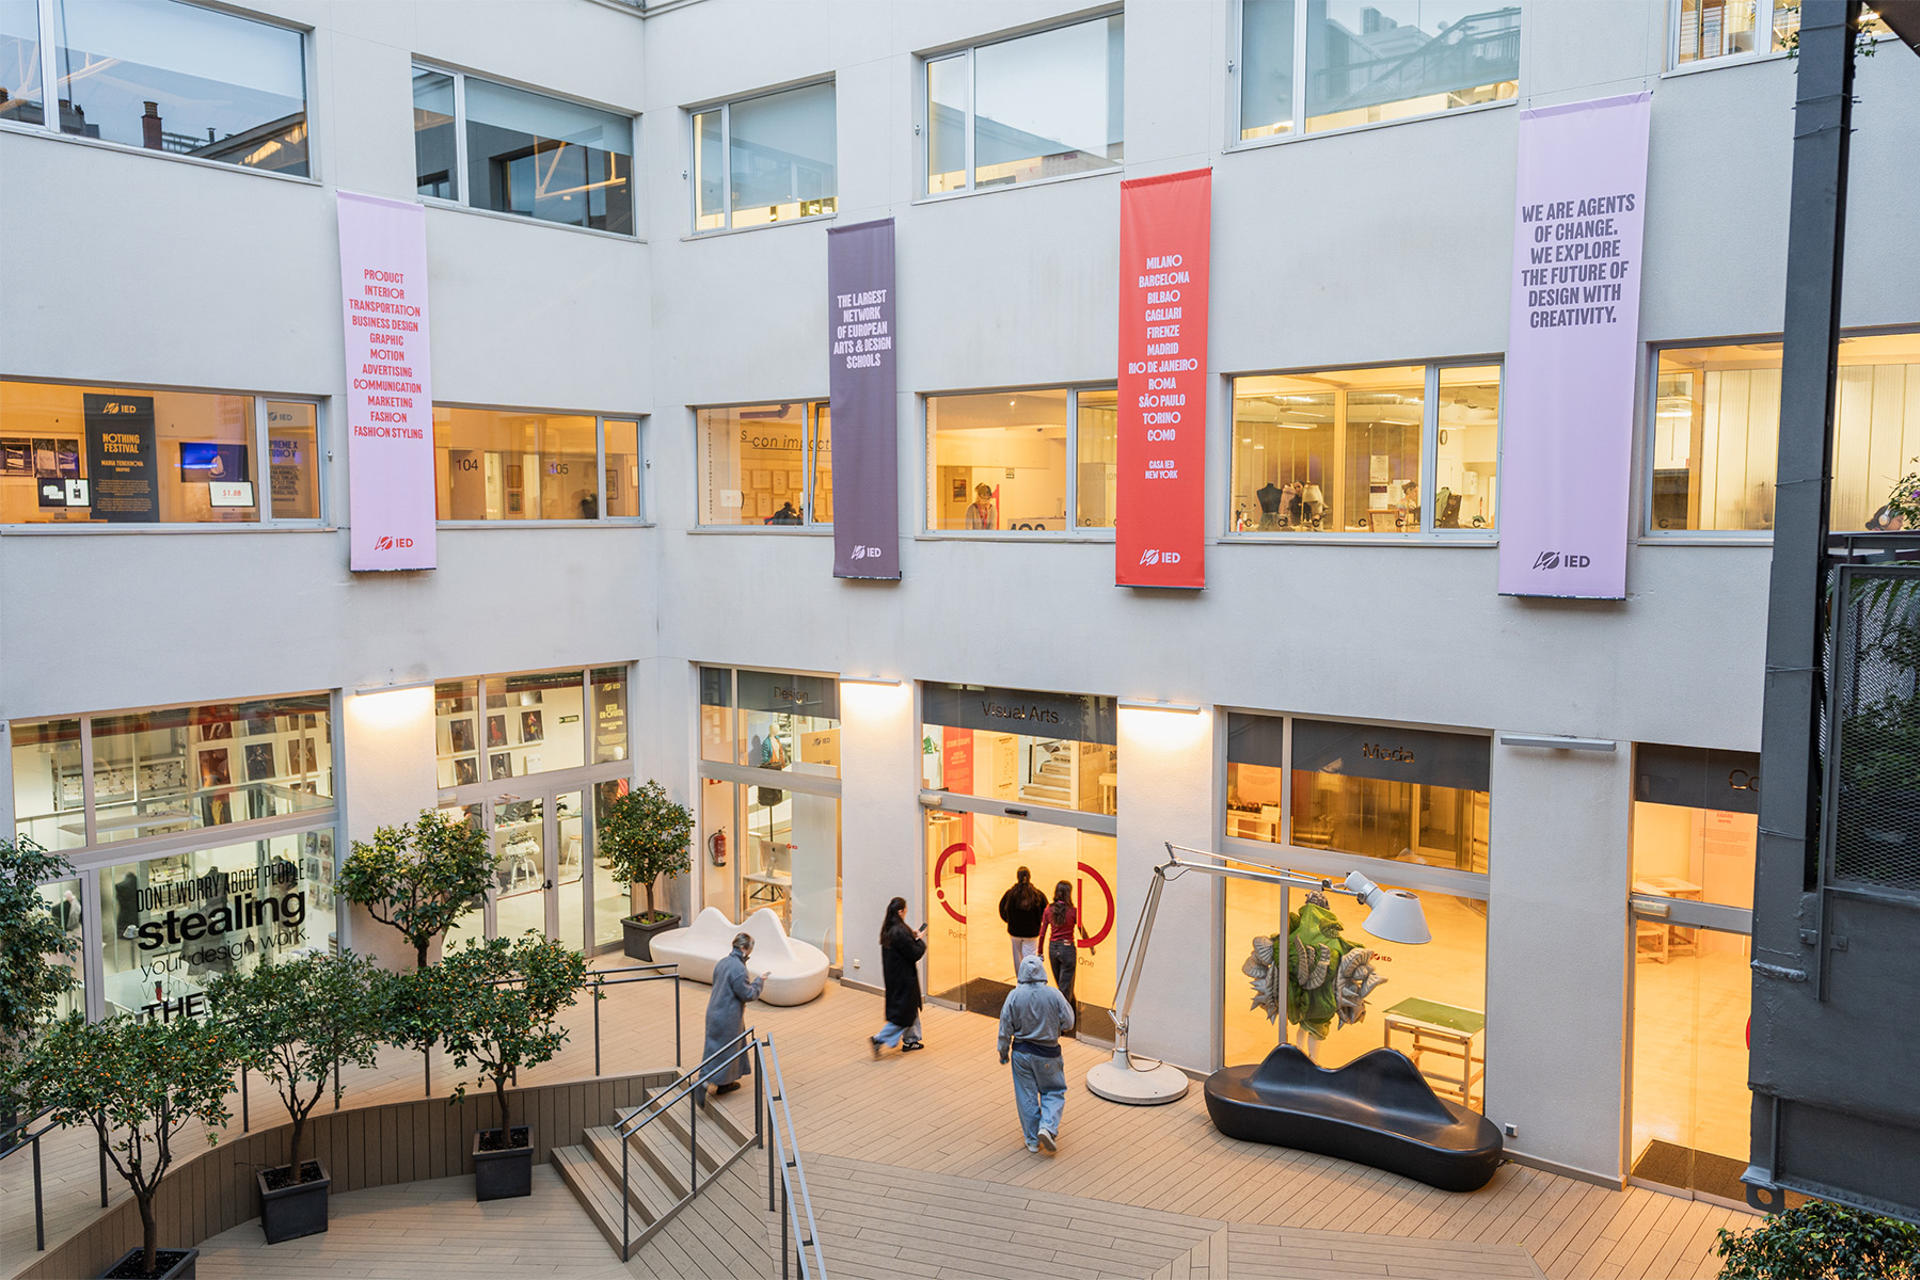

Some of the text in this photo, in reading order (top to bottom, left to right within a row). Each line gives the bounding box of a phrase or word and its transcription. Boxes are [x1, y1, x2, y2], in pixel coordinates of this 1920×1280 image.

[1522, 193, 1635, 223] WE ARE AGENTS
[1534, 218, 1618, 243] OF CHANGE.
[1530, 239, 1621, 264] WE EXPLORE
[1146, 254, 1183, 270] MILANO
[364, 268, 404, 284] PRODUCT
[1138, 271, 1190, 288] BARCELONA
[1521, 260, 1629, 287] THE FUTURE OF
[364, 284, 405, 300] INTERIOR
[837, 289, 887, 308] THE LARGEST
[1147, 289, 1181, 304] BILBAO
[1528, 283, 1621, 307] DESIGN WITH
[349, 298, 421, 317] TRANSPORTATION
[843, 305, 881, 323] NETWORK
[1145, 306, 1182, 322] CAGLIARI
[352, 315, 419, 332] BUSINESS DESIGN
[1530, 305, 1617, 329] CREATIVITY.
[837, 321, 888, 339] OF EUROPEAN
[1146, 324, 1180, 339] FIRENZE
[369, 332, 404, 346] GRAPHIC
[833, 336, 892, 355] ARTS & DESIGN
[370, 348, 405, 361] MOTION
[1147, 342, 1179, 356] MADRID
[846, 353, 881, 369] SCHOOLS
[1128, 358, 1198, 374] RIO DE JANEIRO
[362, 363, 413, 378] ADVERTISING
[353, 378, 422, 394] COMMUNICATION
[1148, 377, 1177, 390] ROMA
[367, 395, 413, 409] MARKETING
[1138, 393, 1186, 408] SÃO PAULO
[121, 404, 137, 414] IED
[370, 411, 408, 423] FASHION
[1142, 411, 1181, 425] TORINO
[102, 433, 141, 445] NOTHING
[353, 425, 424, 440] FASHION STYLING
[1147, 428, 1176, 442] COMO
[104, 443, 140, 454] FESTIVAL
[752, 436, 778, 448] con
[457, 458, 479, 472] 104
[550, 463, 569, 475] 105
[1149, 460, 1175, 470] CASA IED
[1144, 469, 1178, 480] NEW YORK
[396, 537, 414, 548] IED
[866, 547, 882, 558] IED
[1161, 552, 1181, 564] IED
[1564, 555, 1591, 568] IED
[774, 686, 809, 704] Design
[982, 701, 1059, 724] Visual Arts
[1362, 742, 1415, 764] Moda
[136, 858, 305, 912] DON'T WORRY ABOUT PEOPLE
[137, 890, 306, 950] stealing
[140, 926, 311, 983] your design work.
[141, 991, 204, 1024] THE
